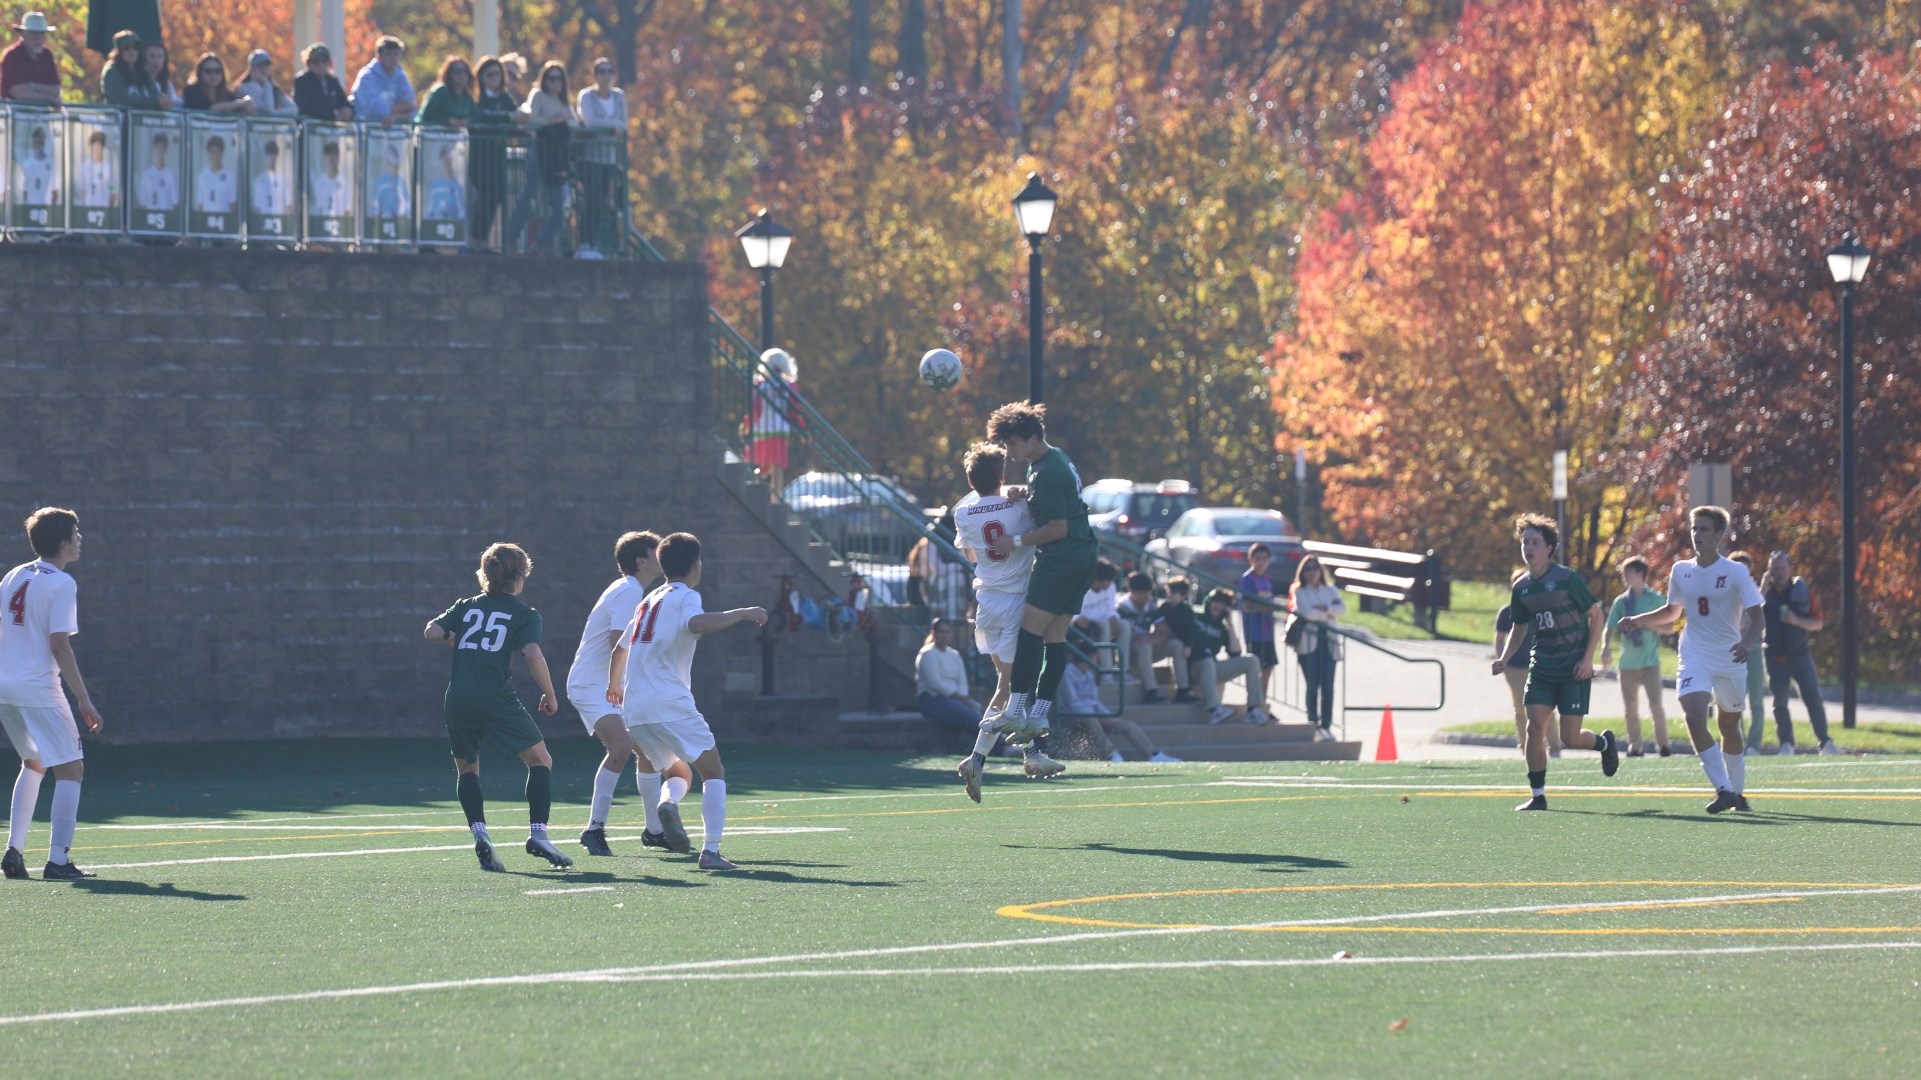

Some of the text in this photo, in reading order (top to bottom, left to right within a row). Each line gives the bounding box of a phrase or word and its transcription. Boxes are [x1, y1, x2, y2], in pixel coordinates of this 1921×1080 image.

[87, 211, 105, 227] #7
[146, 213, 165, 229] #5
[207, 215, 225, 231] #4
[967, 501, 1014, 515] MINUTEMEN
[981, 520, 1009, 562] 9
[8, 578, 32, 626] 4
[1697, 596, 1709, 616] 8
[457, 608, 513, 652] 25
[1535, 611, 1555, 630] 28
